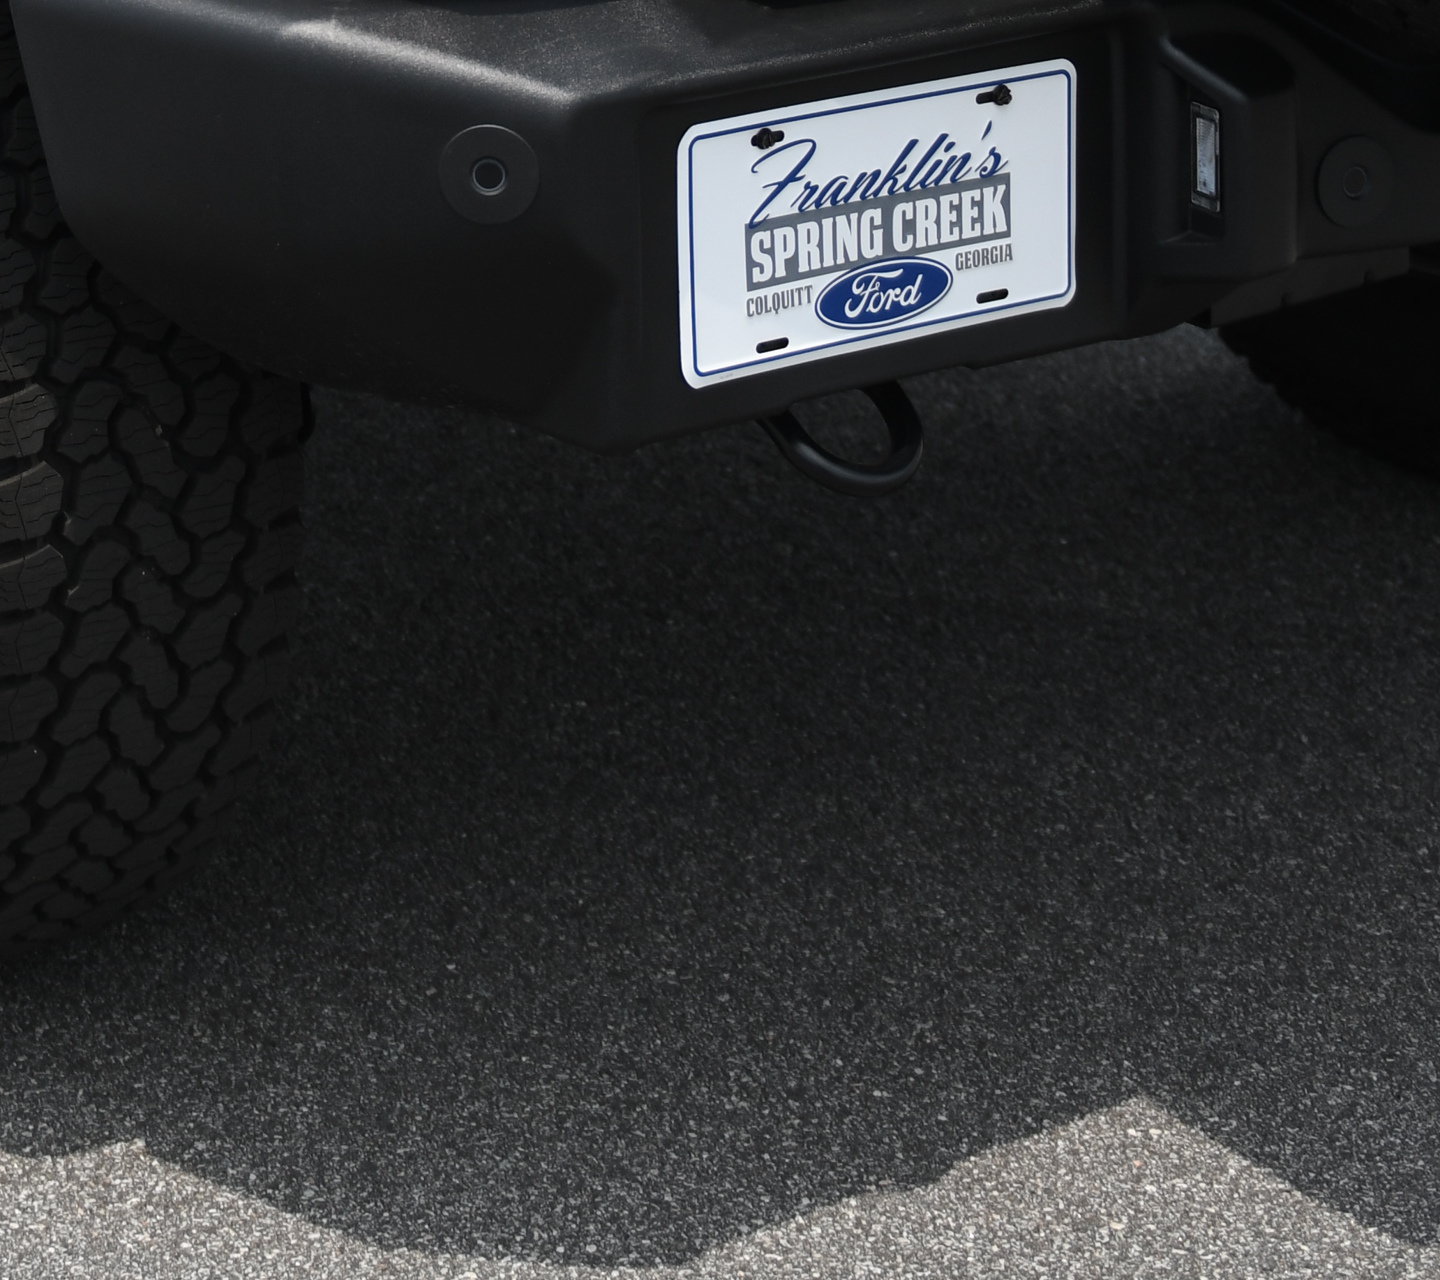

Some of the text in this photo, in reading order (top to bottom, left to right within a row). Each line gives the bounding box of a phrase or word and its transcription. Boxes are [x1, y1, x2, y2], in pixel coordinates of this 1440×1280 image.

[749, 120, 1010, 229] Franklin's
[750, 183, 1009, 284] SPRING CREEK
[955, 243, 1014, 272] GEORGIA
[746, 285, 814, 318] COLQUITT
[843, 267, 925, 319] Ford
